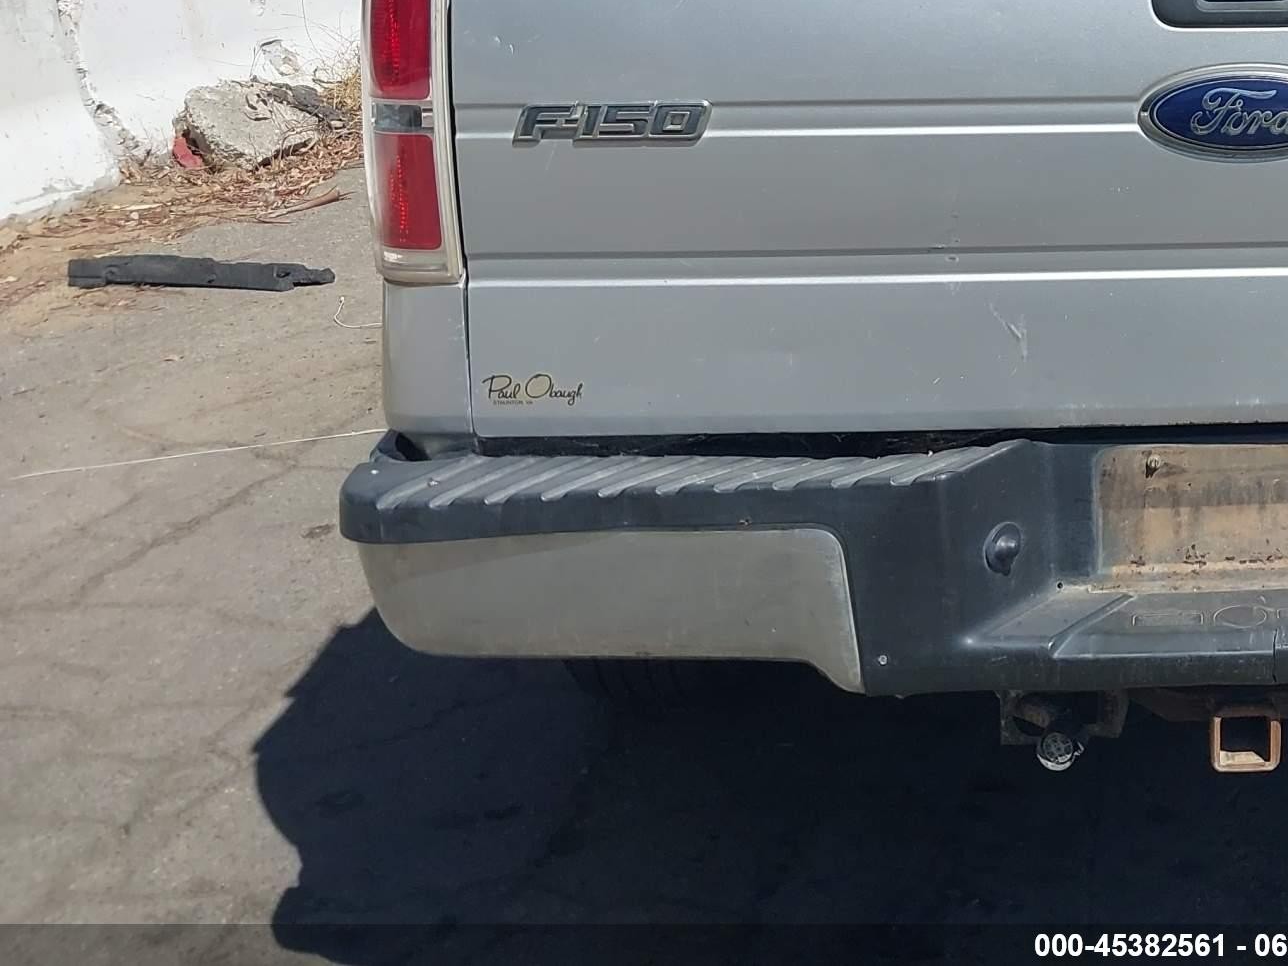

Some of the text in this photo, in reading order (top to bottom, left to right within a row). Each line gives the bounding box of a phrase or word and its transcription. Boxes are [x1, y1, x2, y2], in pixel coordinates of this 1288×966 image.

[512, 100, 713, 147] F-150
[482, 373, 584, 406] Paul Obaugh
